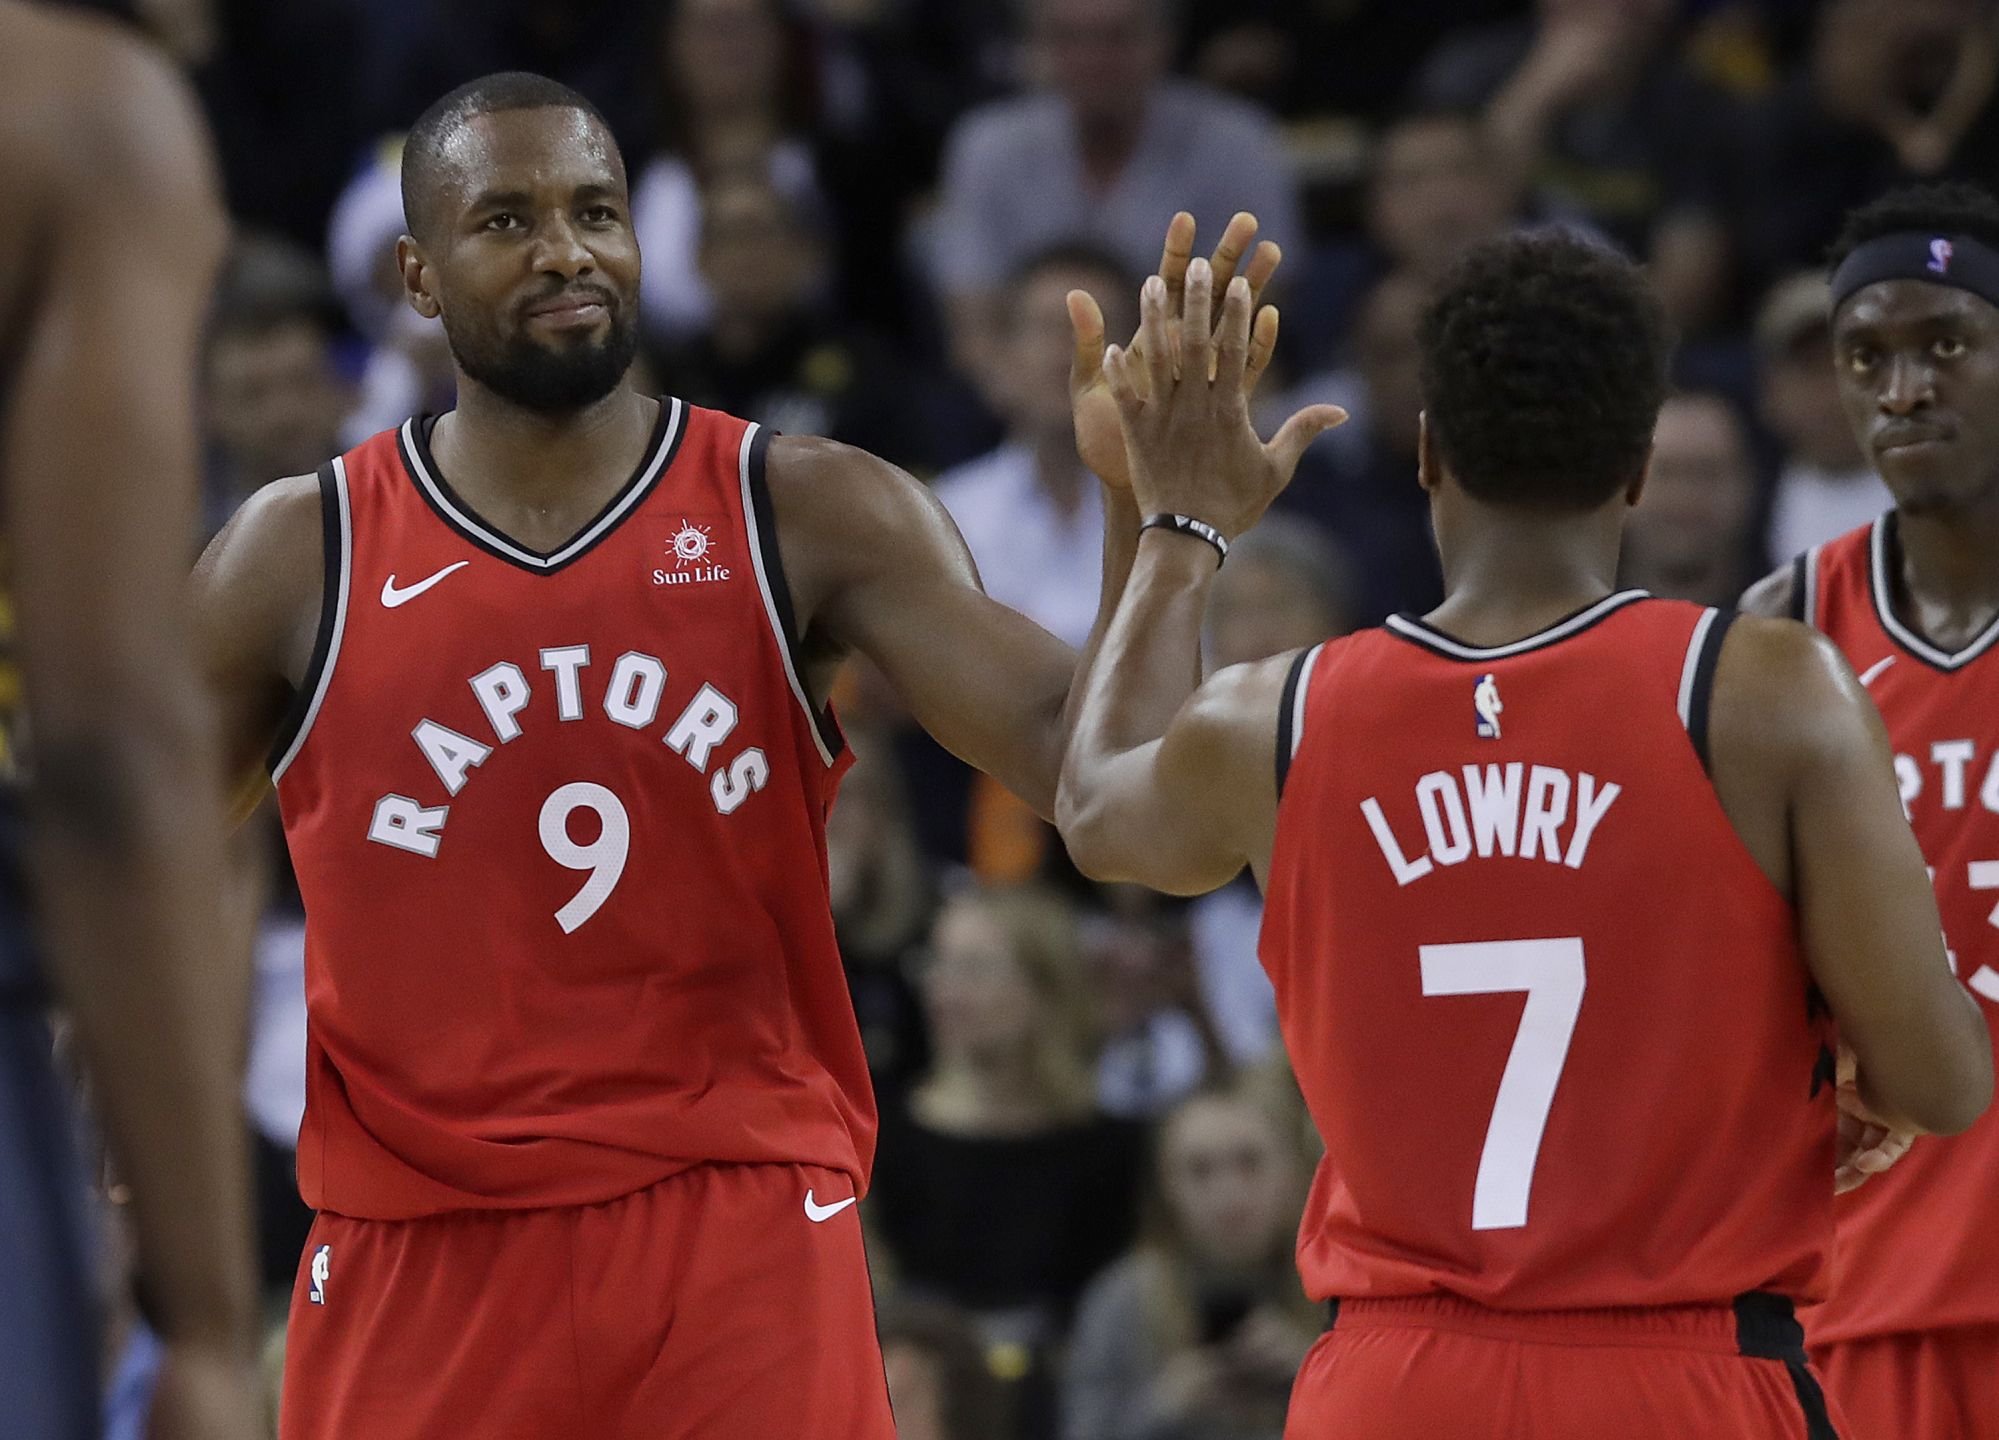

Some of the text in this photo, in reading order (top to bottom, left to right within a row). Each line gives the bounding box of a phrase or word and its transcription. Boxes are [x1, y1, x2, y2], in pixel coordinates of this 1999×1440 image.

[653, 565, 730, 585] Sun Life
[367, 644, 770, 858] RAPTORS
[1360, 762, 1622, 886] LOWRY
[538, 781, 630, 934] 9
[1418, 937, 1587, 1230] 7
